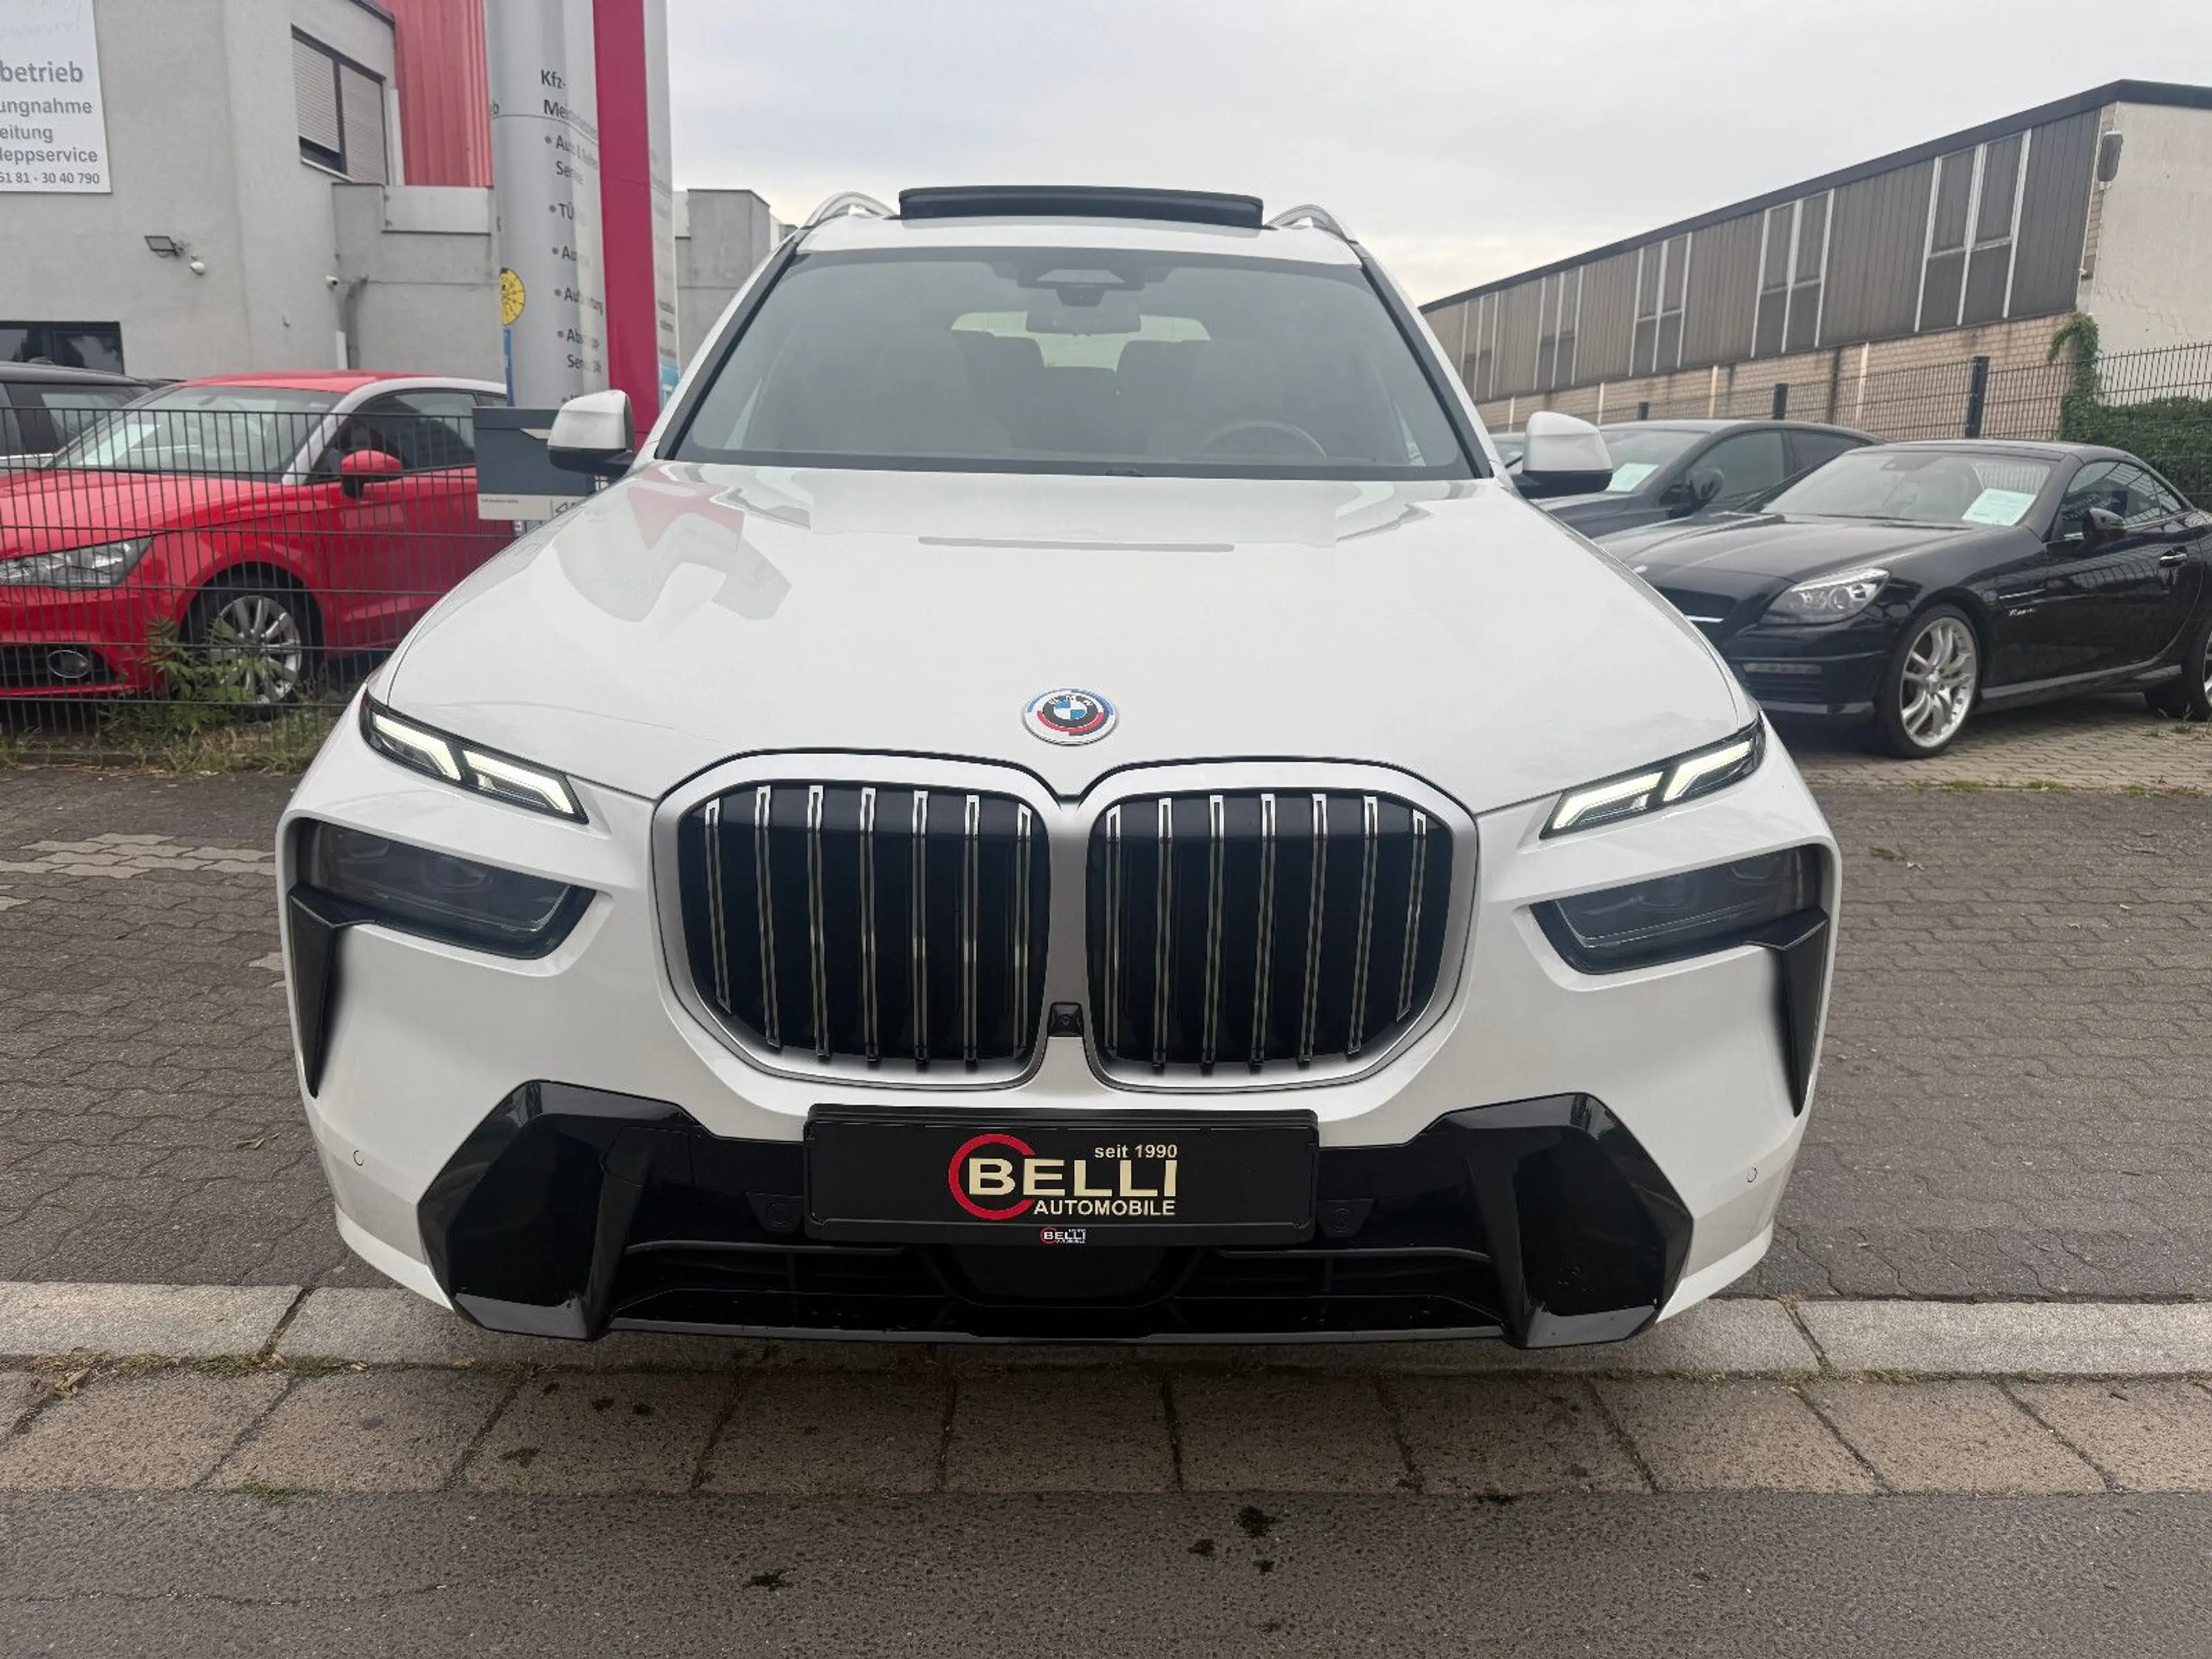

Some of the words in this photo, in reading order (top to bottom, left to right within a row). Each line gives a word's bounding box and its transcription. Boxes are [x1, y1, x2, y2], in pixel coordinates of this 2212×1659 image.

[0, 61, 84, 82] betrieb
[15, 171, 30, 183] 81
[41, 172, 56, 183] 30
[59, 172, 74, 183] 40
[77, 172, 100, 184] 790
[1094, 1145, 1128, 1158] seit
[1134, 1144, 1178, 1158] 1990
[968, 1158, 1177, 1197] BELLI
[1033, 1199, 1176, 1217] AUTOMOBILE
[1043, 1231, 1086, 1240] BELLI
